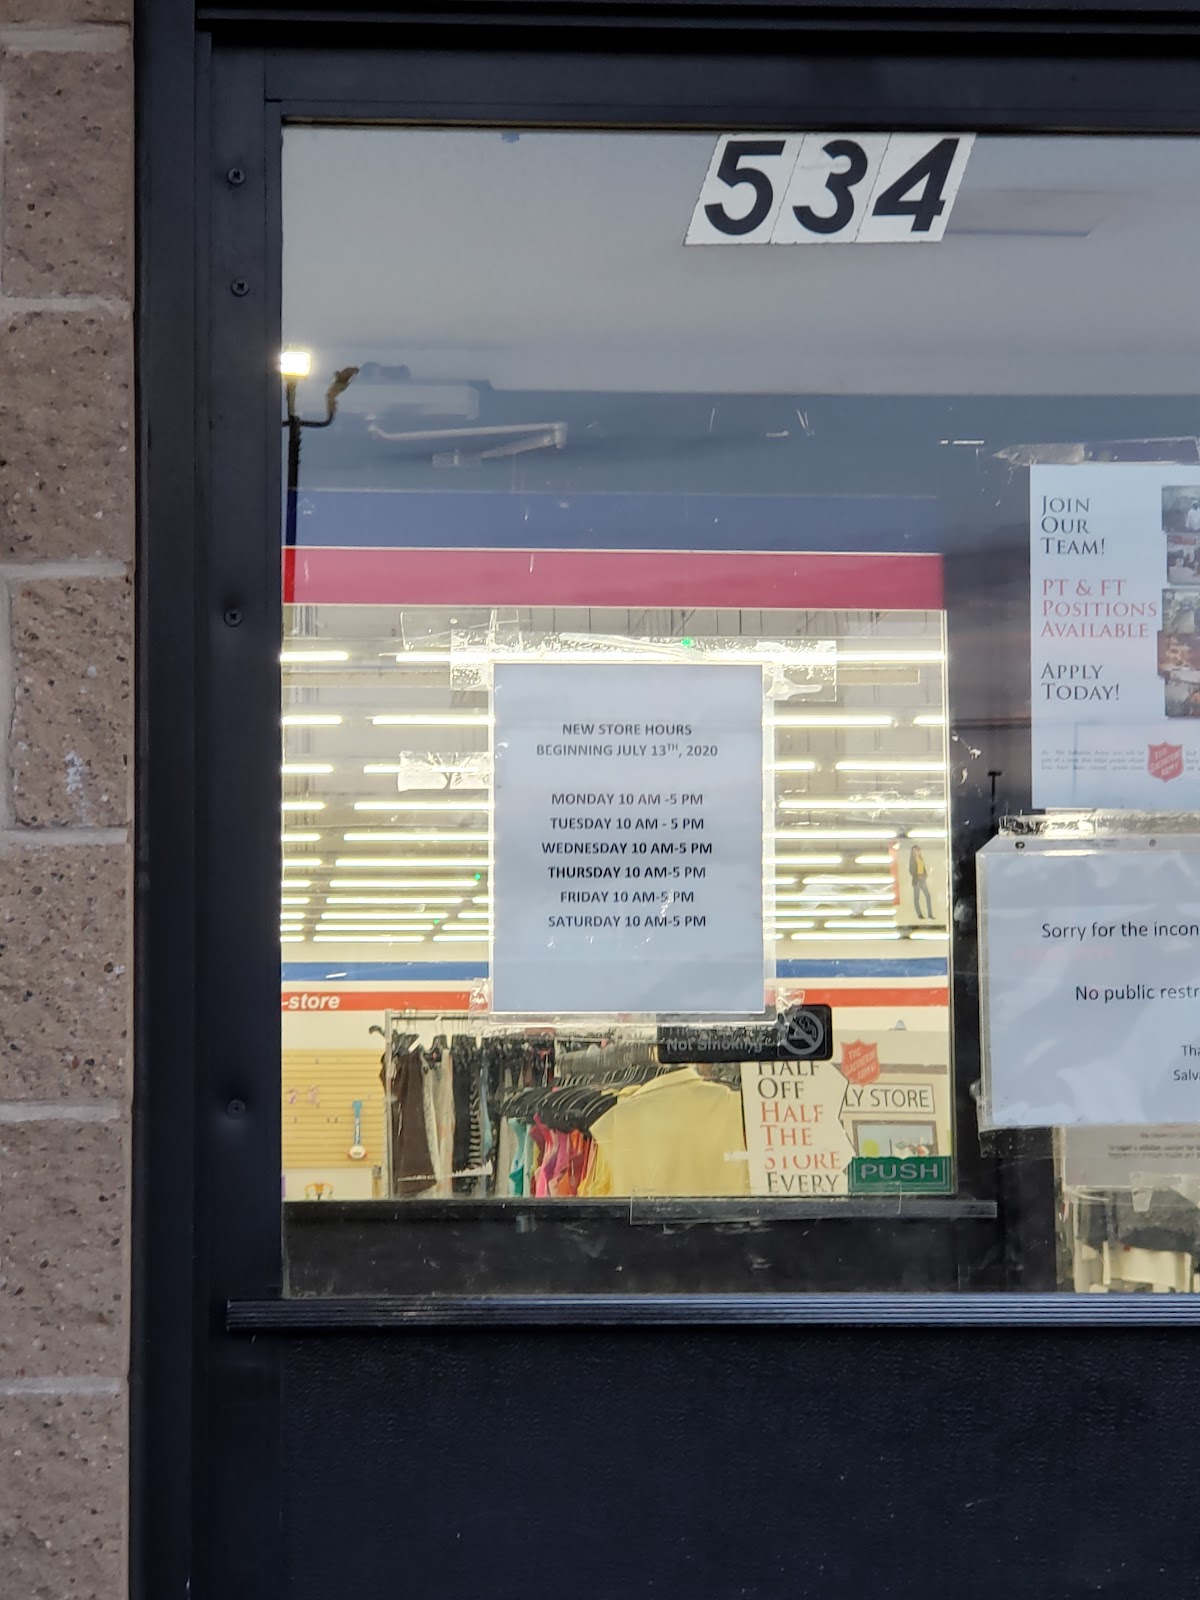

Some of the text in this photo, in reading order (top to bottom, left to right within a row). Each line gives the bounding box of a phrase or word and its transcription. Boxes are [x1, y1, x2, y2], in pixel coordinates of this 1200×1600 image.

[704, 138, 960, 235] 534
[1043, 579, 1126, 596] PT & FT
[562, 724, 692, 736] NEW STORE HOURS
[536, 743, 718, 759] BEGINNING JULY 13TH, 2020
[551, 793, 615, 806] MONDAY
[618, 793, 634, 806] 10
[638, 793, 661, 806] AM
[681, 793, 703, 806] PM
[550, 817, 612, 830] TUESDAY
[616, 817, 631, 830] 10
[635, 817, 658, 830] AM
[682, 818, 704, 830] PM
[541, 842, 713, 855] WEDNESDAY 10 AM-5 PM
[547, 866, 706, 879] THURSDAY 10 AM-5 PM
[560, 891, 609, 903] FRIDAY
[613, 891, 628, 903] 10
[673, 891, 694, 903] PM
[548, 915, 706, 928] SATURDAY 10 AM-5 PM
[1042, 921, 1199, 941] Sorry for the incon
[1075, 984, 1200, 1003] No public restr
[1173, 1068, 1200, 1081] Salv
[870, 1088, 930, 1107] STORE
[861, 1163, 938, 1179] PUSH
